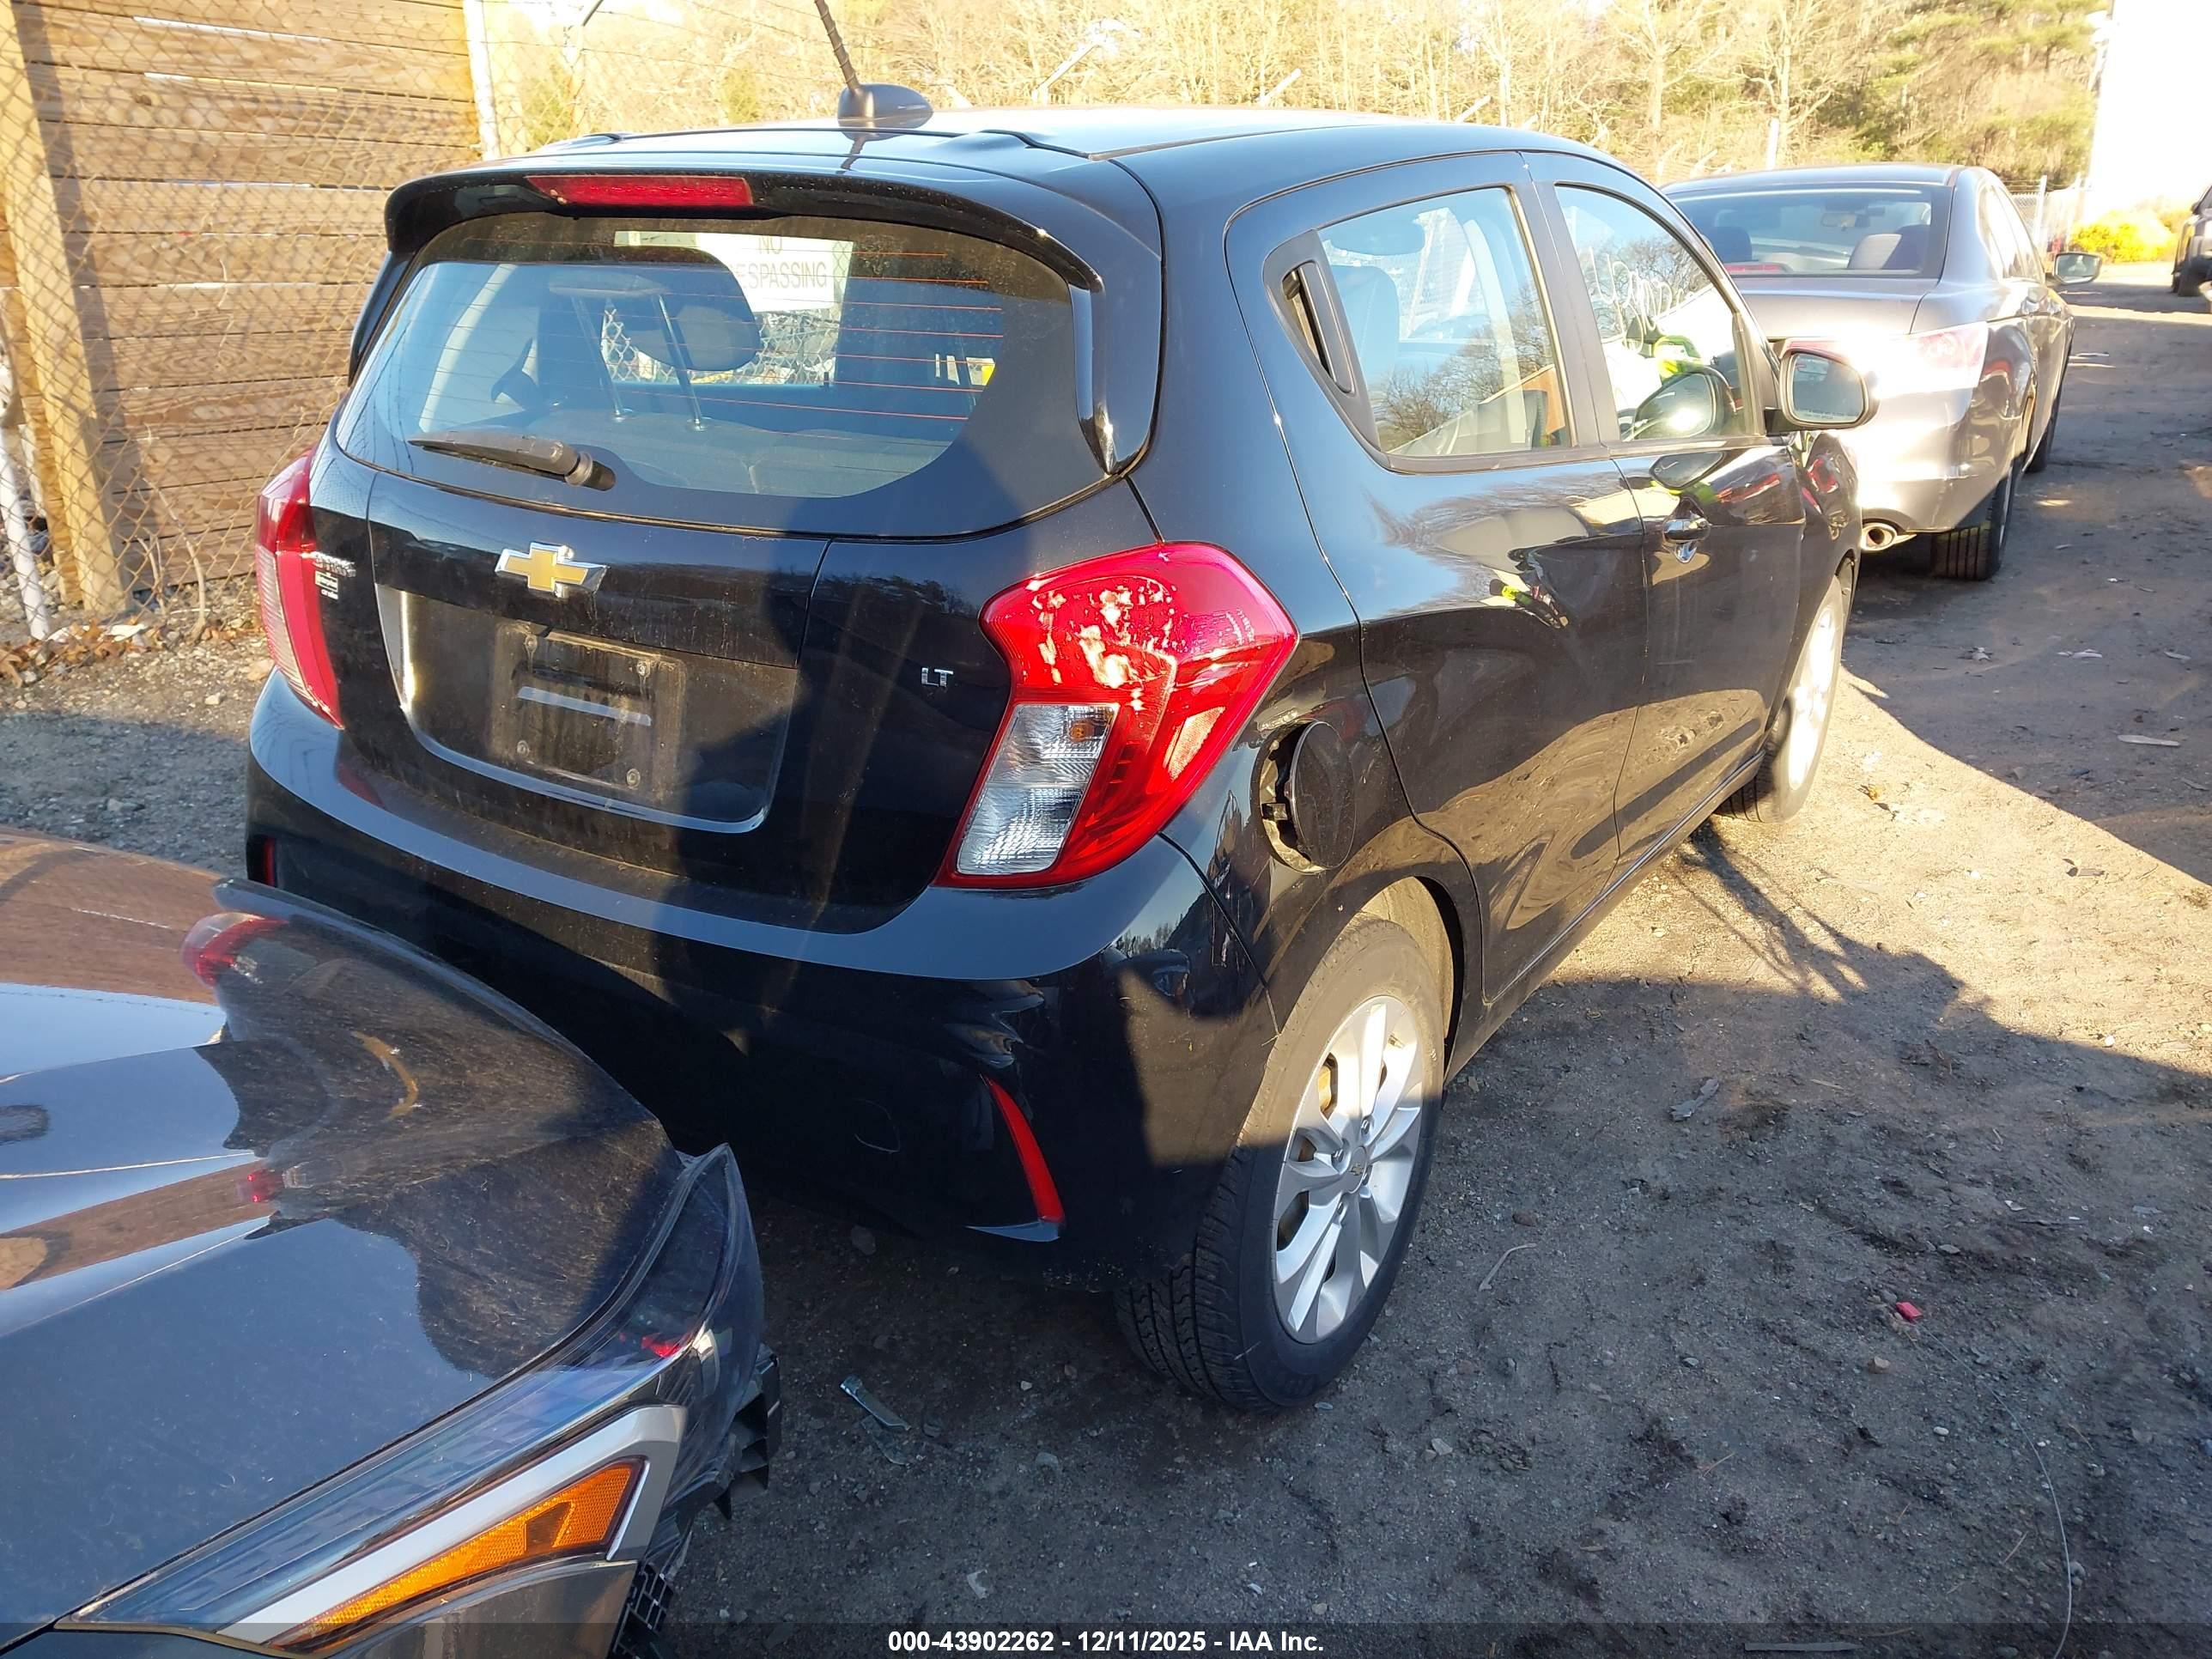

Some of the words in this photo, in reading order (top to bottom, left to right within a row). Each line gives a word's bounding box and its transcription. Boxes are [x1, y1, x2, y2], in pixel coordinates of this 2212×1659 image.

[757, 235, 784, 255] NO
[730, 260, 828, 289] ESPASSING
[921, 667, 954, 688] LT
